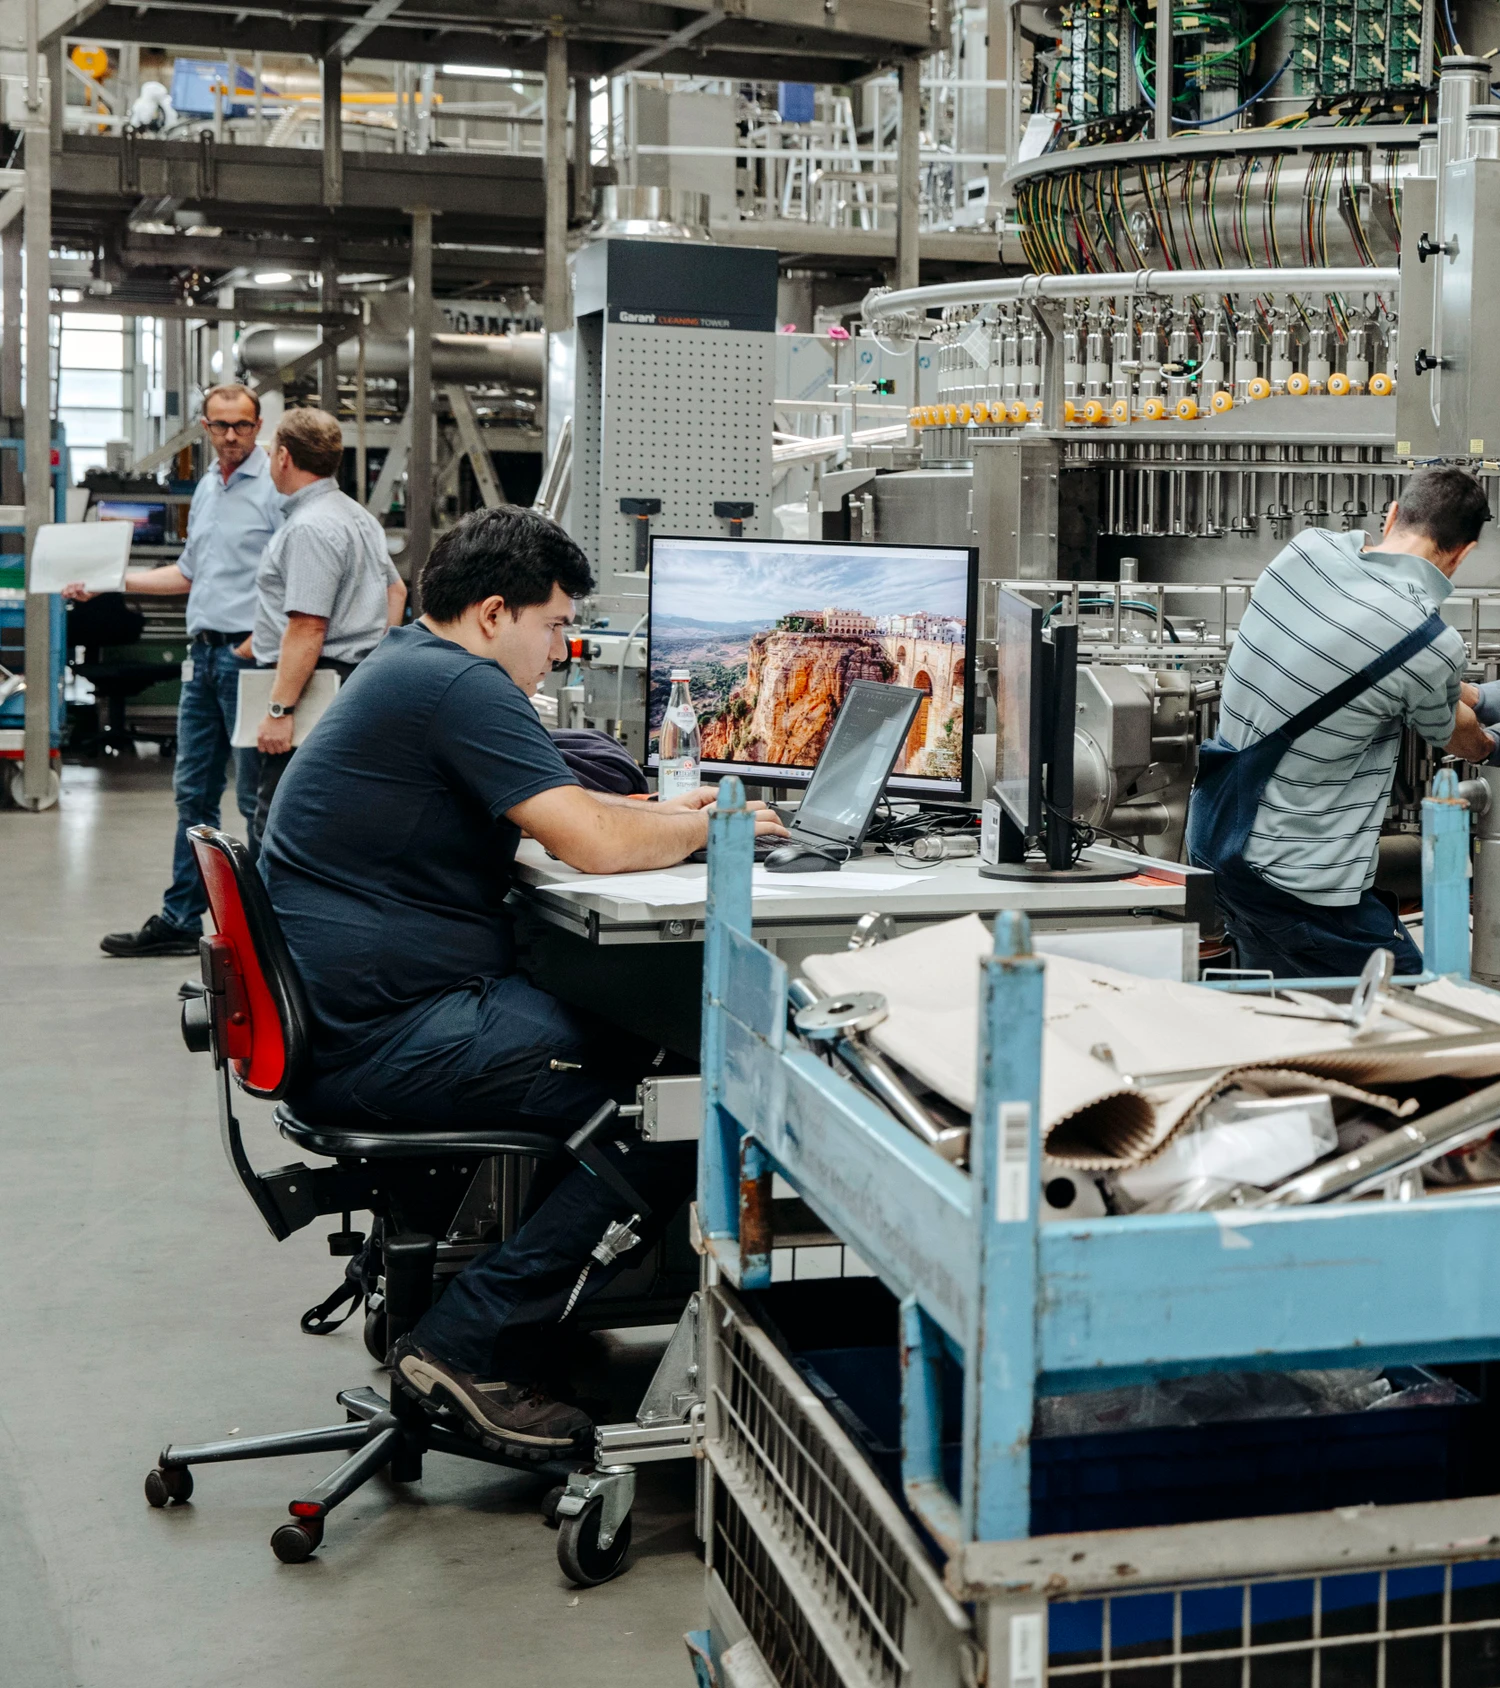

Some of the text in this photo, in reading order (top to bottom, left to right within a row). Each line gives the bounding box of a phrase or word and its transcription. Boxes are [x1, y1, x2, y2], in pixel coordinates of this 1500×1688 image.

[619, 311, 730, 328] Garant CLEANING TOWER
